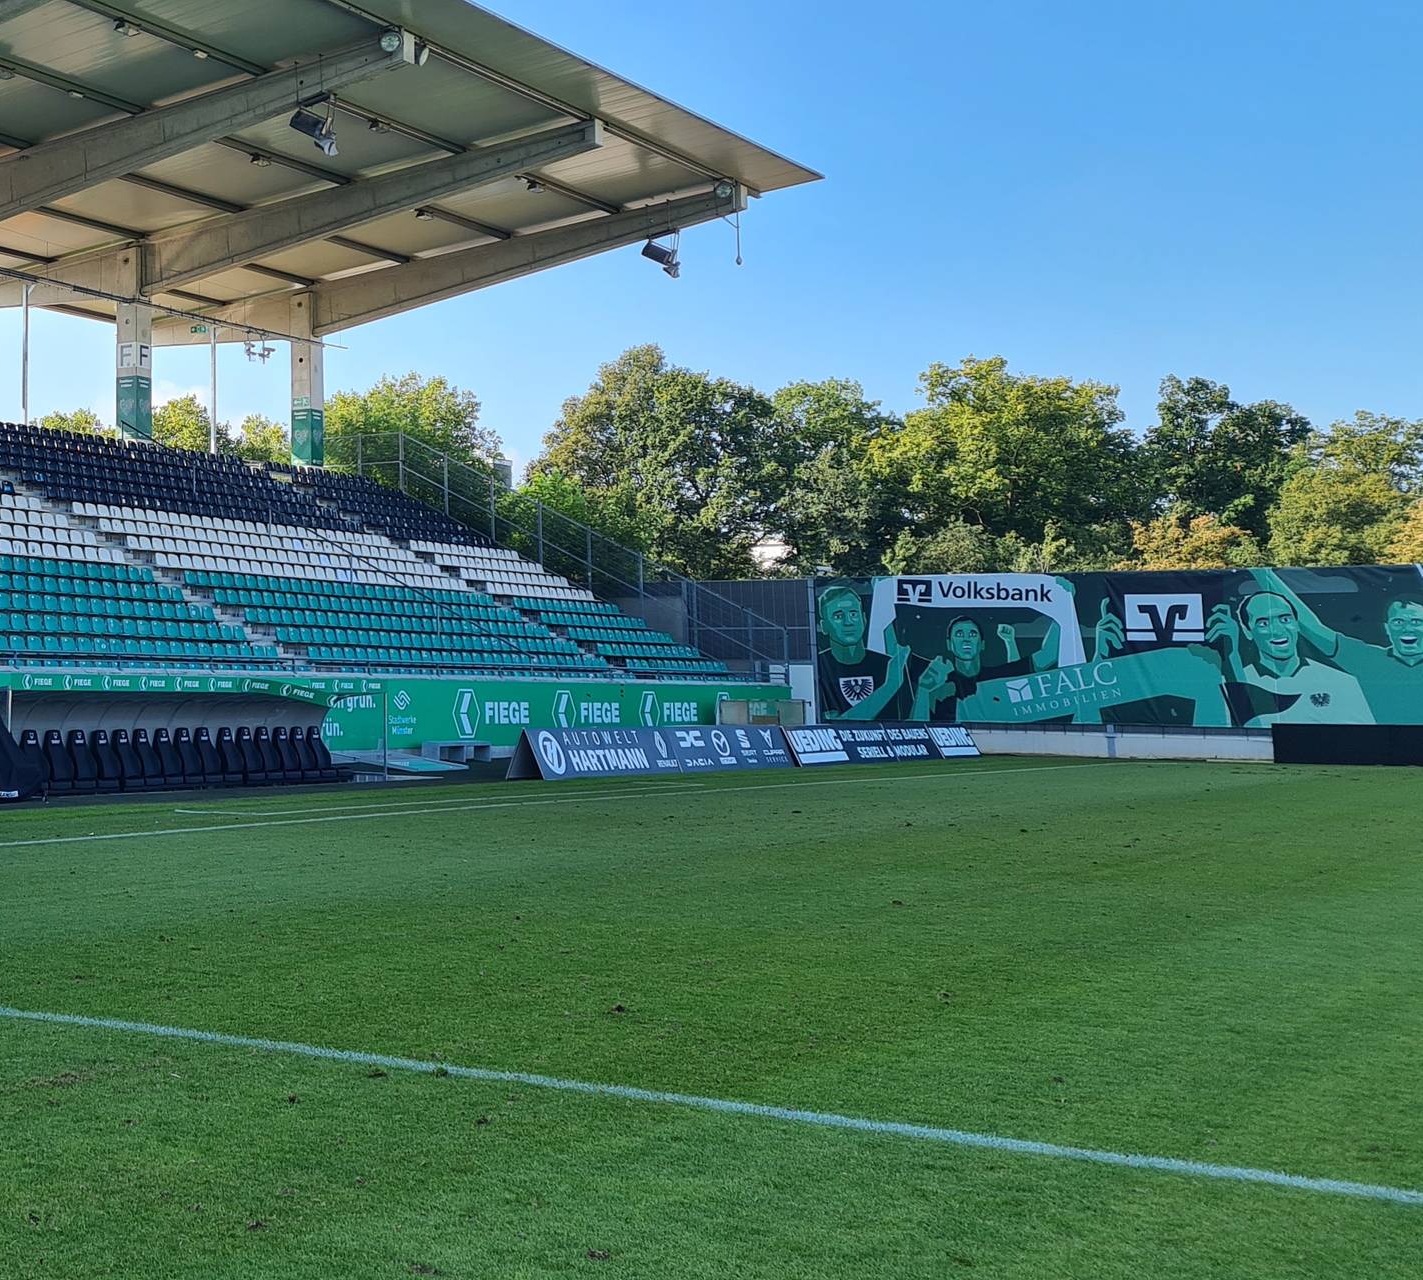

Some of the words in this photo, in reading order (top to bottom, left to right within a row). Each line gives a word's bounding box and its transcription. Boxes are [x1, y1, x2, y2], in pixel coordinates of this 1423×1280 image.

[120, 344, 133, 367] F
[139, 344, 150, 367] F
[937, 580, 1053, 603] Volksbank
[33, 677, 53, 687] FIEGE
[73, 678, 92, 687] FIEGE
[112, 678, 130, 687] FIEGE
[149, 679, 166, 688] FIEGE
[183, 680, 200, 688] FIEGE
[217, 680, 233, 689] FIEGE
[251, 681, 270, 690] FIEGE
[1034, 661, 1118, 698] FALC
[292, 688, 315, 699] FIEGE
[1013, 687, 1122, 717] IMMOBILIEN
[484, 701, 530, 725] FIEGE
[580, 702, 620, 724] FIEGE
[662, 702, 699, 722] FIEGE
[562, 730, 639, 746] AUTOWELT
[789, 729, 843, 752] UEDING
[838, 730, 855, 742] DIE
[855, 729, 887, 742] ZUKUNFT
[886, 728, 900, 740] DES
[900, 728, 929, 740] BAUENS
[929, 728, 974, 747] UEDING
[568, 748, 650, 772] HARTMANN
[856, 746, 889, 759] SERIELL
[894, 744, 930, 757] MODULAR
